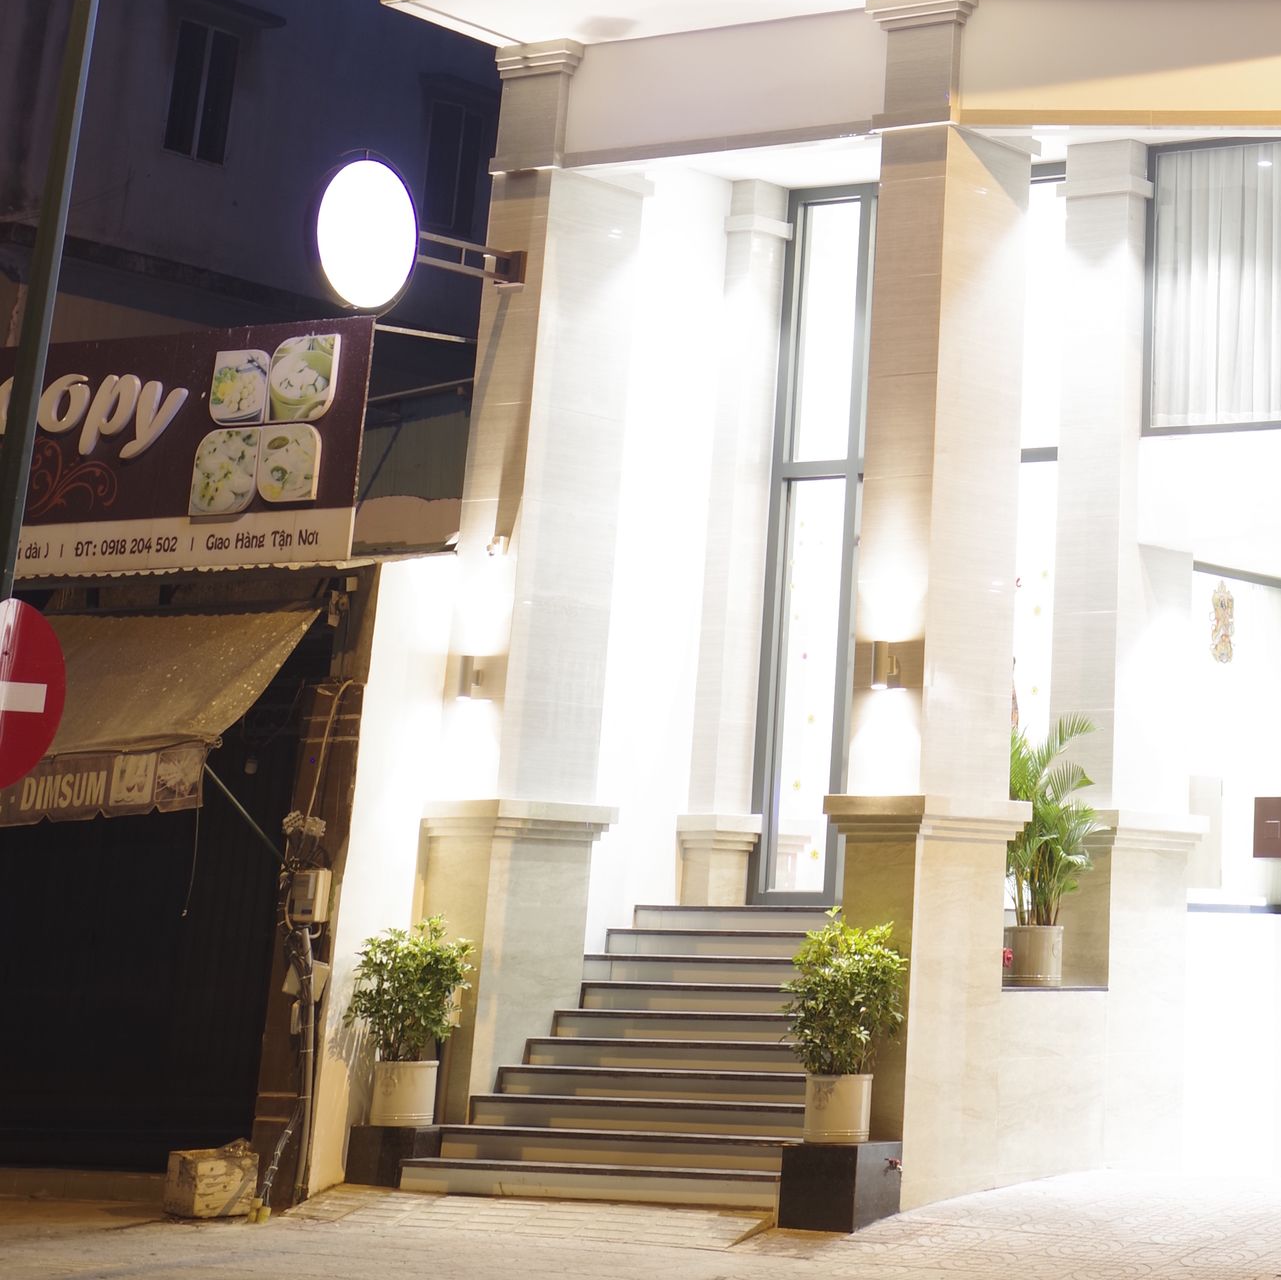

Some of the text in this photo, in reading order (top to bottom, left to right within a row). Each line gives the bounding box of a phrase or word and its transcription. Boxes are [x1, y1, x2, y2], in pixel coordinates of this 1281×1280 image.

[74, 540, 97, 557] ĐT:
[101, 538, 127, 556] 0918
[130, 537, 152, 555] 204
[155, 536, 178, 553] 502
[206, 534, 230, 551] Giao
[235, 531, 265, 549] Hàng
[271, 530, 292, 551] Tận
[298, 529, 319, 546] Nơi
[20, 771, 107, 811] DIMSUM
